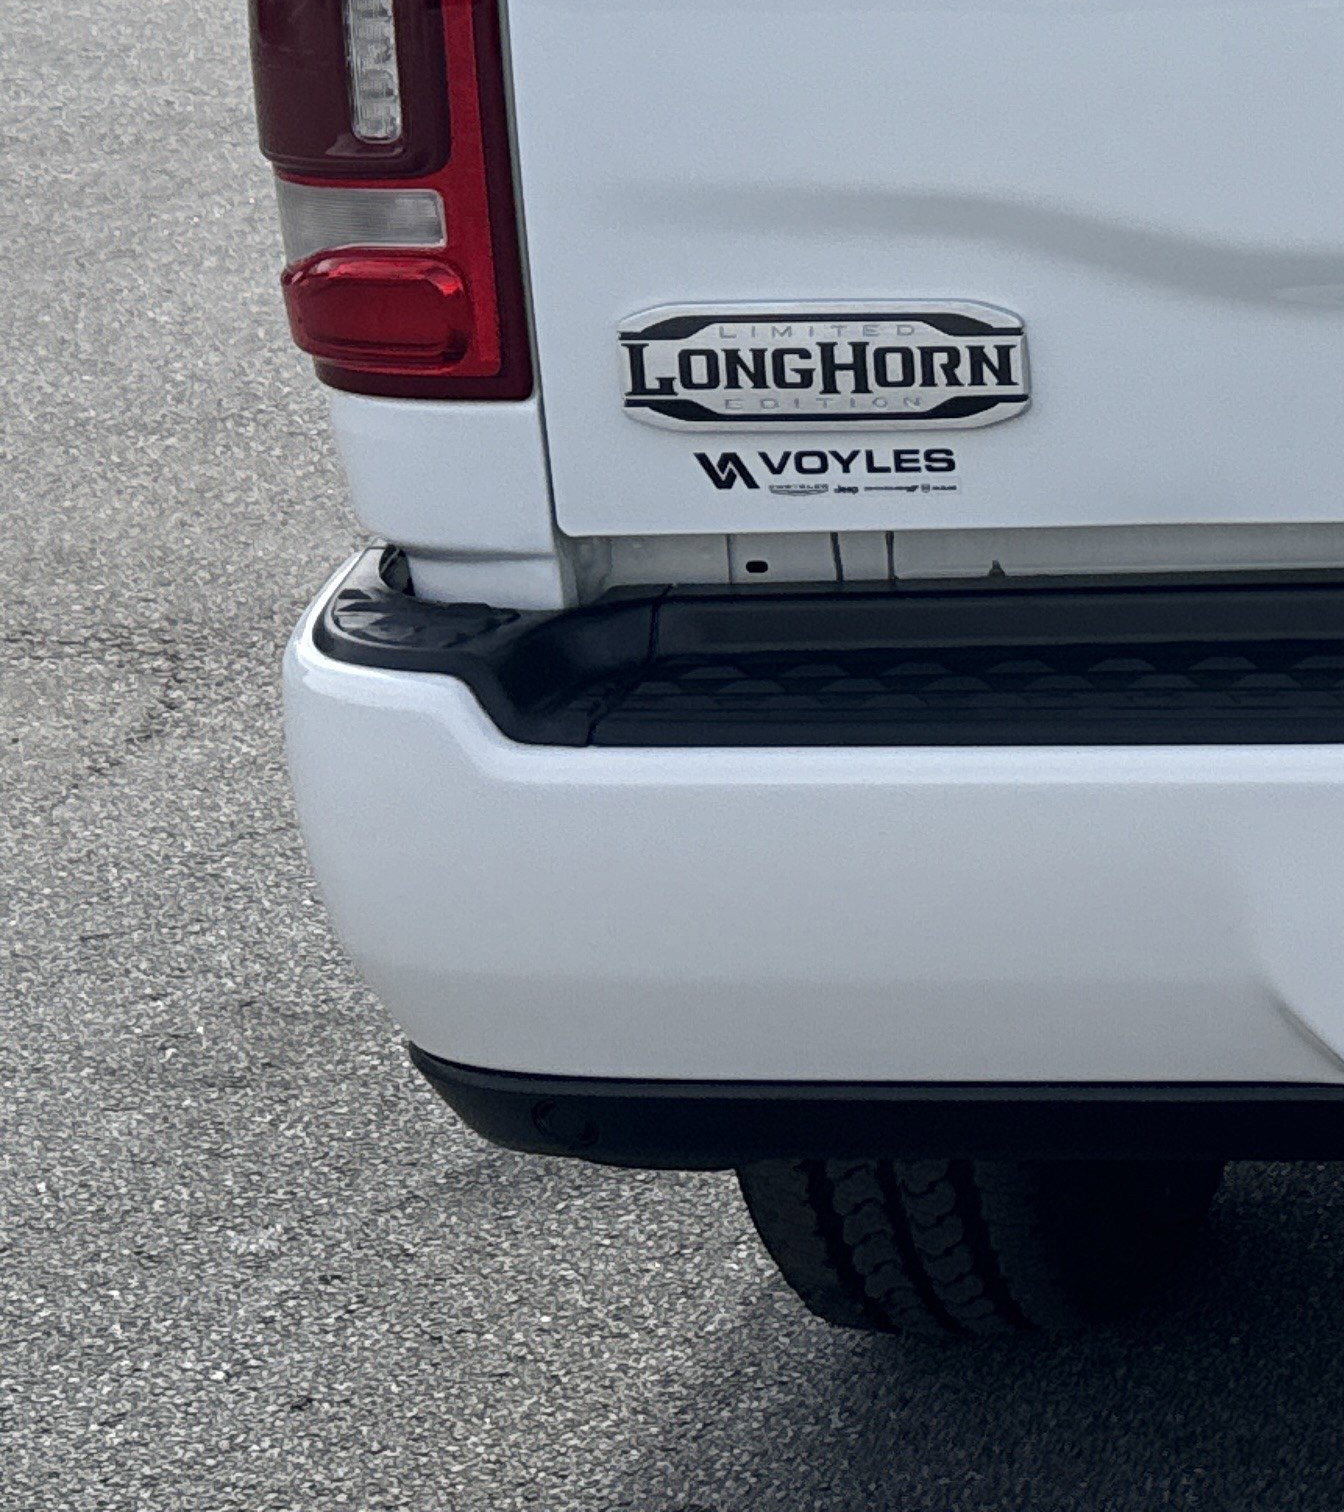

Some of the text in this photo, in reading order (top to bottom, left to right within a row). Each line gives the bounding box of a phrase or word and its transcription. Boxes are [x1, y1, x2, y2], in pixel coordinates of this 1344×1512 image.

[718, 324, 916, 340] LIMITED
[724, 396, 924, 410] EDITION
[757, 448, 956, 475] VOYLES
